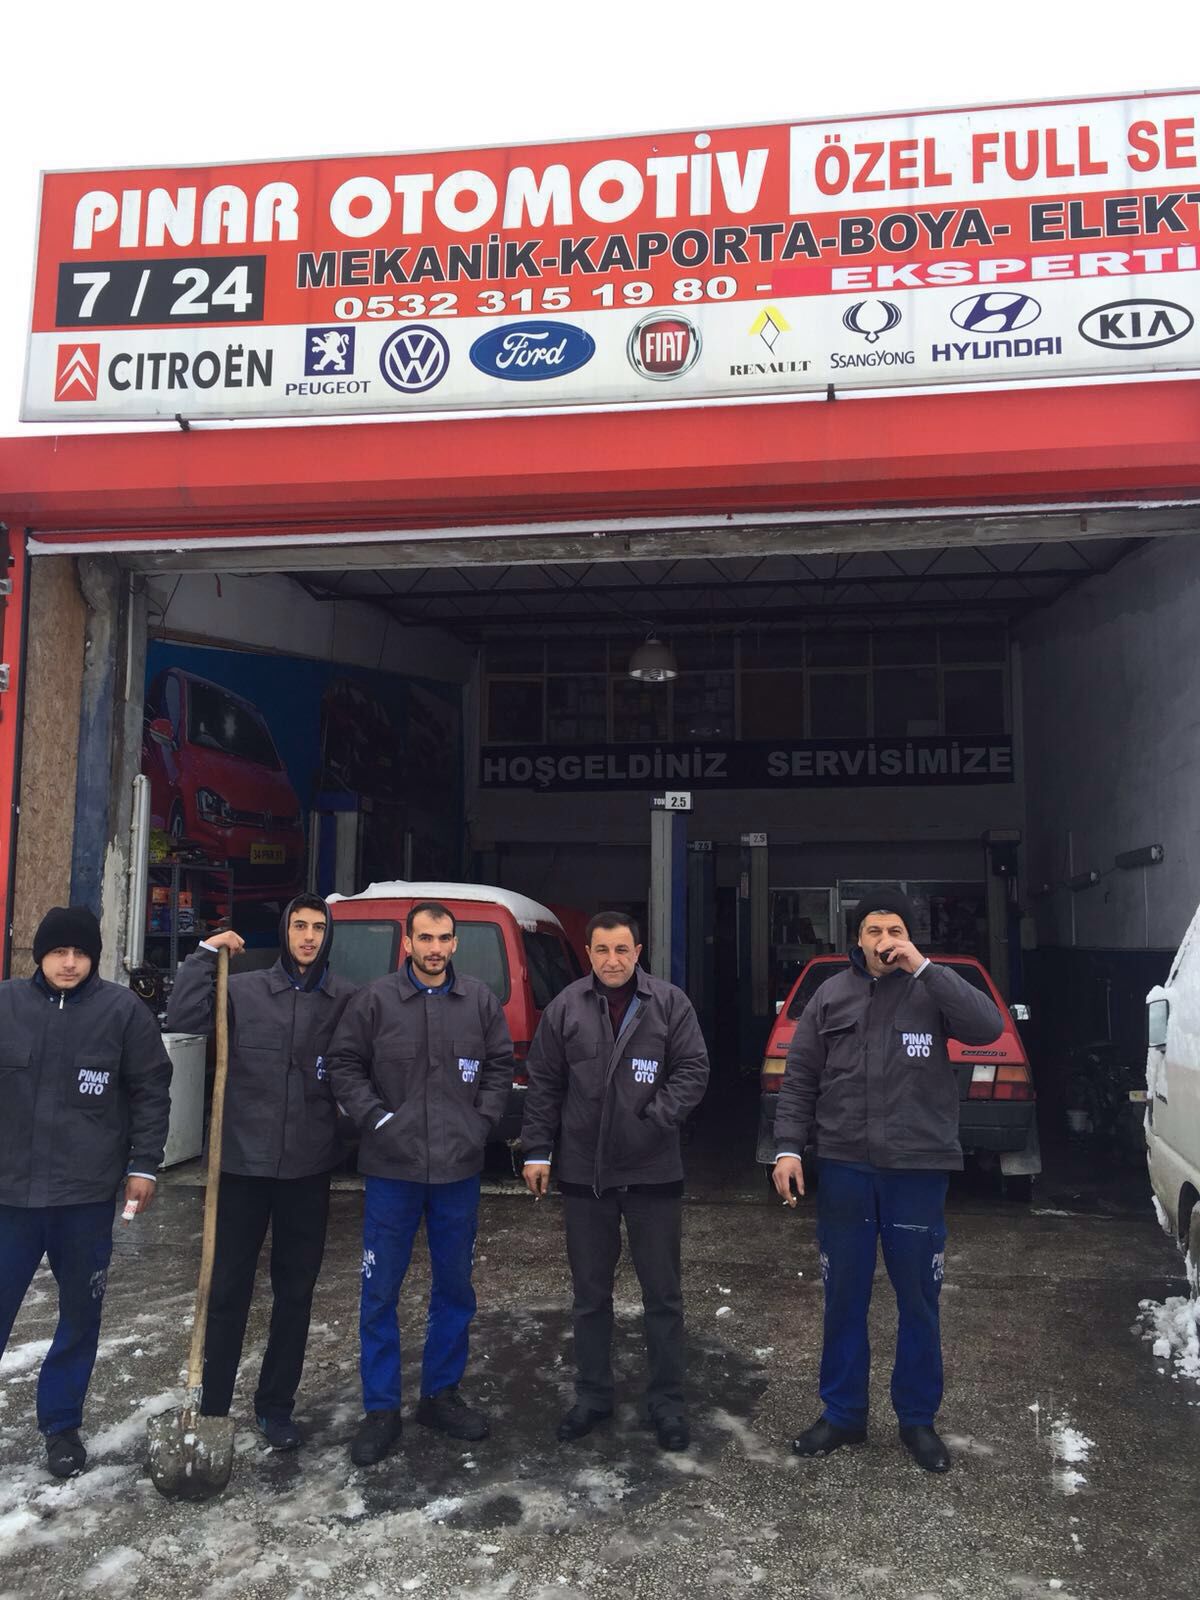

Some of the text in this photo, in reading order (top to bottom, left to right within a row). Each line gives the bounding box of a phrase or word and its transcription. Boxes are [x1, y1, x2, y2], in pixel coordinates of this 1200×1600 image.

[815, 117, 1197, 196] ÖZEL FULL SE
[73, 133, 769, 250] PINAR OTOMOTİV
[72, 271, 111, 318] 7
[169, 265, 253, 316] 24
[334, 293, 458, 320] 0532
[477, 286, 572, 314] 315
[592, 281, 653, 307] 19
[672, 275, 737, 302] 80
[1100, 310, 1176, 340] KIA
[496, 331, 568, 369] Ford
[645, 331, 687, 363] FIAT
[932, 336, 1062, 362] HYUNDAI
[108, 344, 273, 391] CITROËN
[730, 360, 812, 376] RENAULT
[285, 380, 372, 396] PEUGEOT
[483, 742, 1012, 788] HOŞGELDİNİZ SERVİSİMİZE
[671, 796, 687, 808] 2.5
[902, 1033, 933, 1046] PINAR
[907, 1044, 930, 1057] OTO
[458, 1058, 480, 1072] PINAR
[632, 1058, 659, 1073] PINAR
[78, 1068, 110, 1085] PINAR
[635, 1071, 655, 1084] OTO
[79, 1082, 104, 1096] OTO
